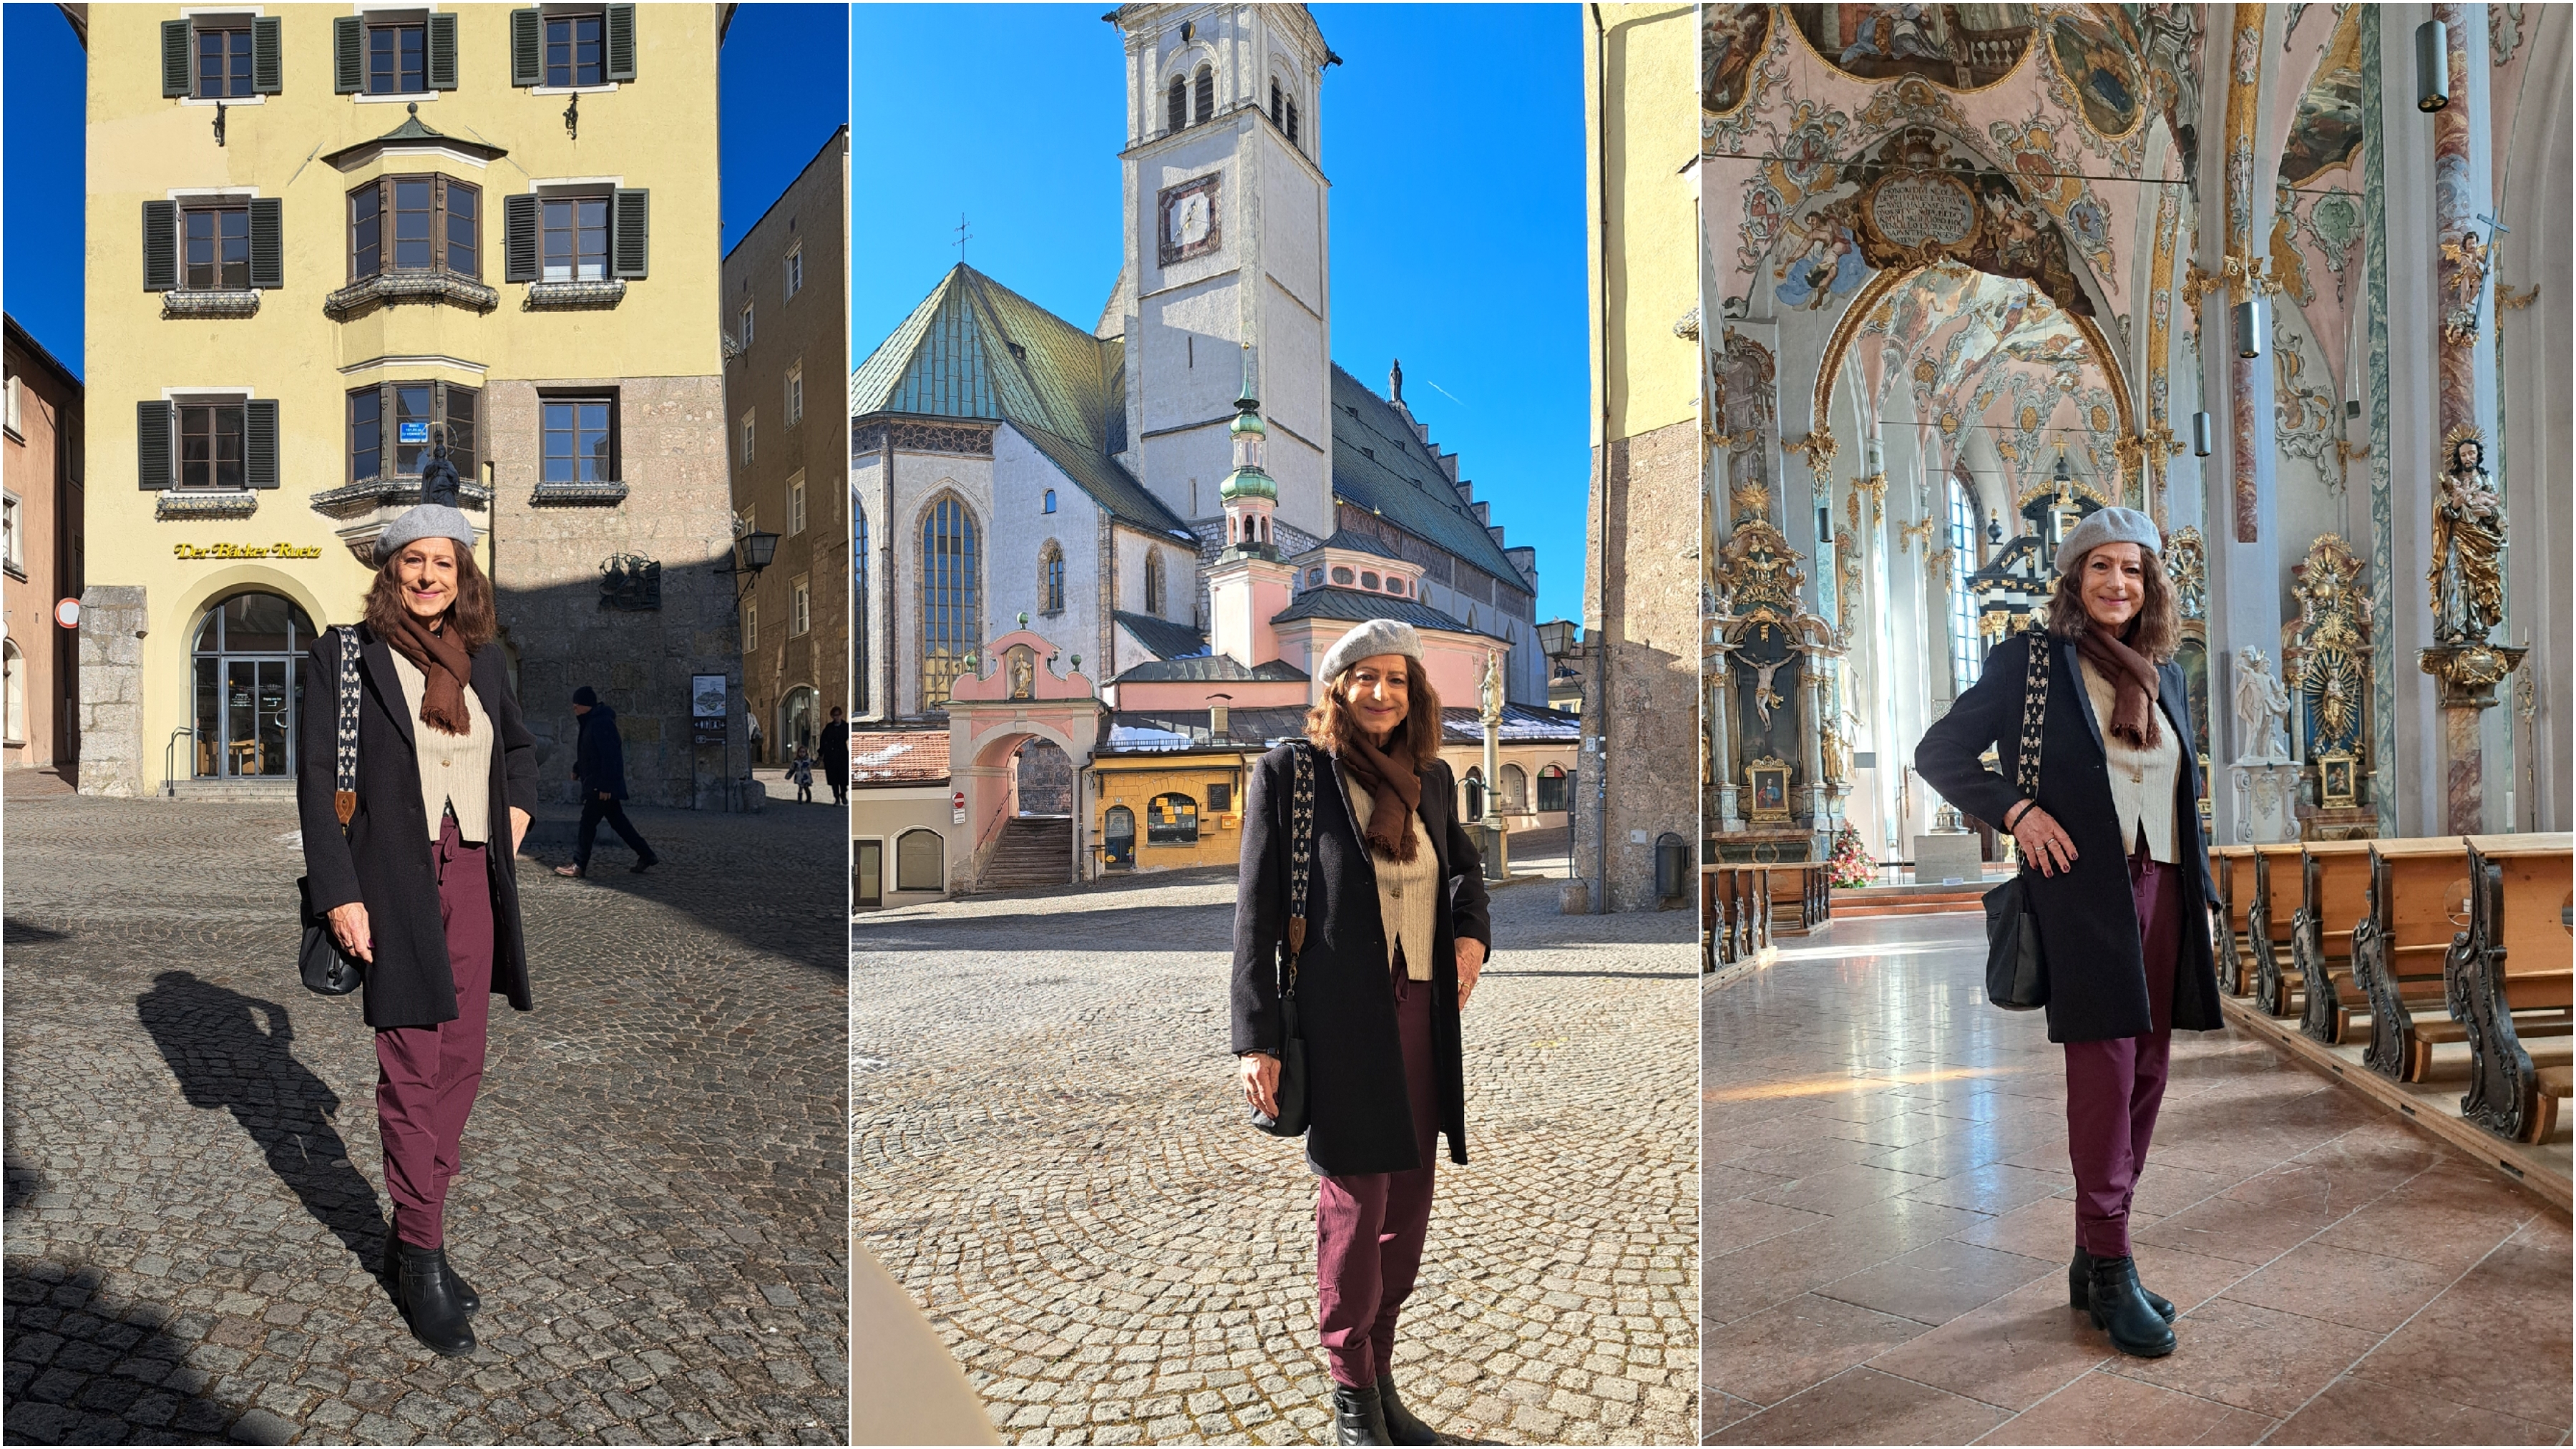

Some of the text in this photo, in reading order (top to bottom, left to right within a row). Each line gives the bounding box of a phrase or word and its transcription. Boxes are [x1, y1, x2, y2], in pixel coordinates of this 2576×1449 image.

[174, 542, 321, 558] Der Bäcker Ruetz
